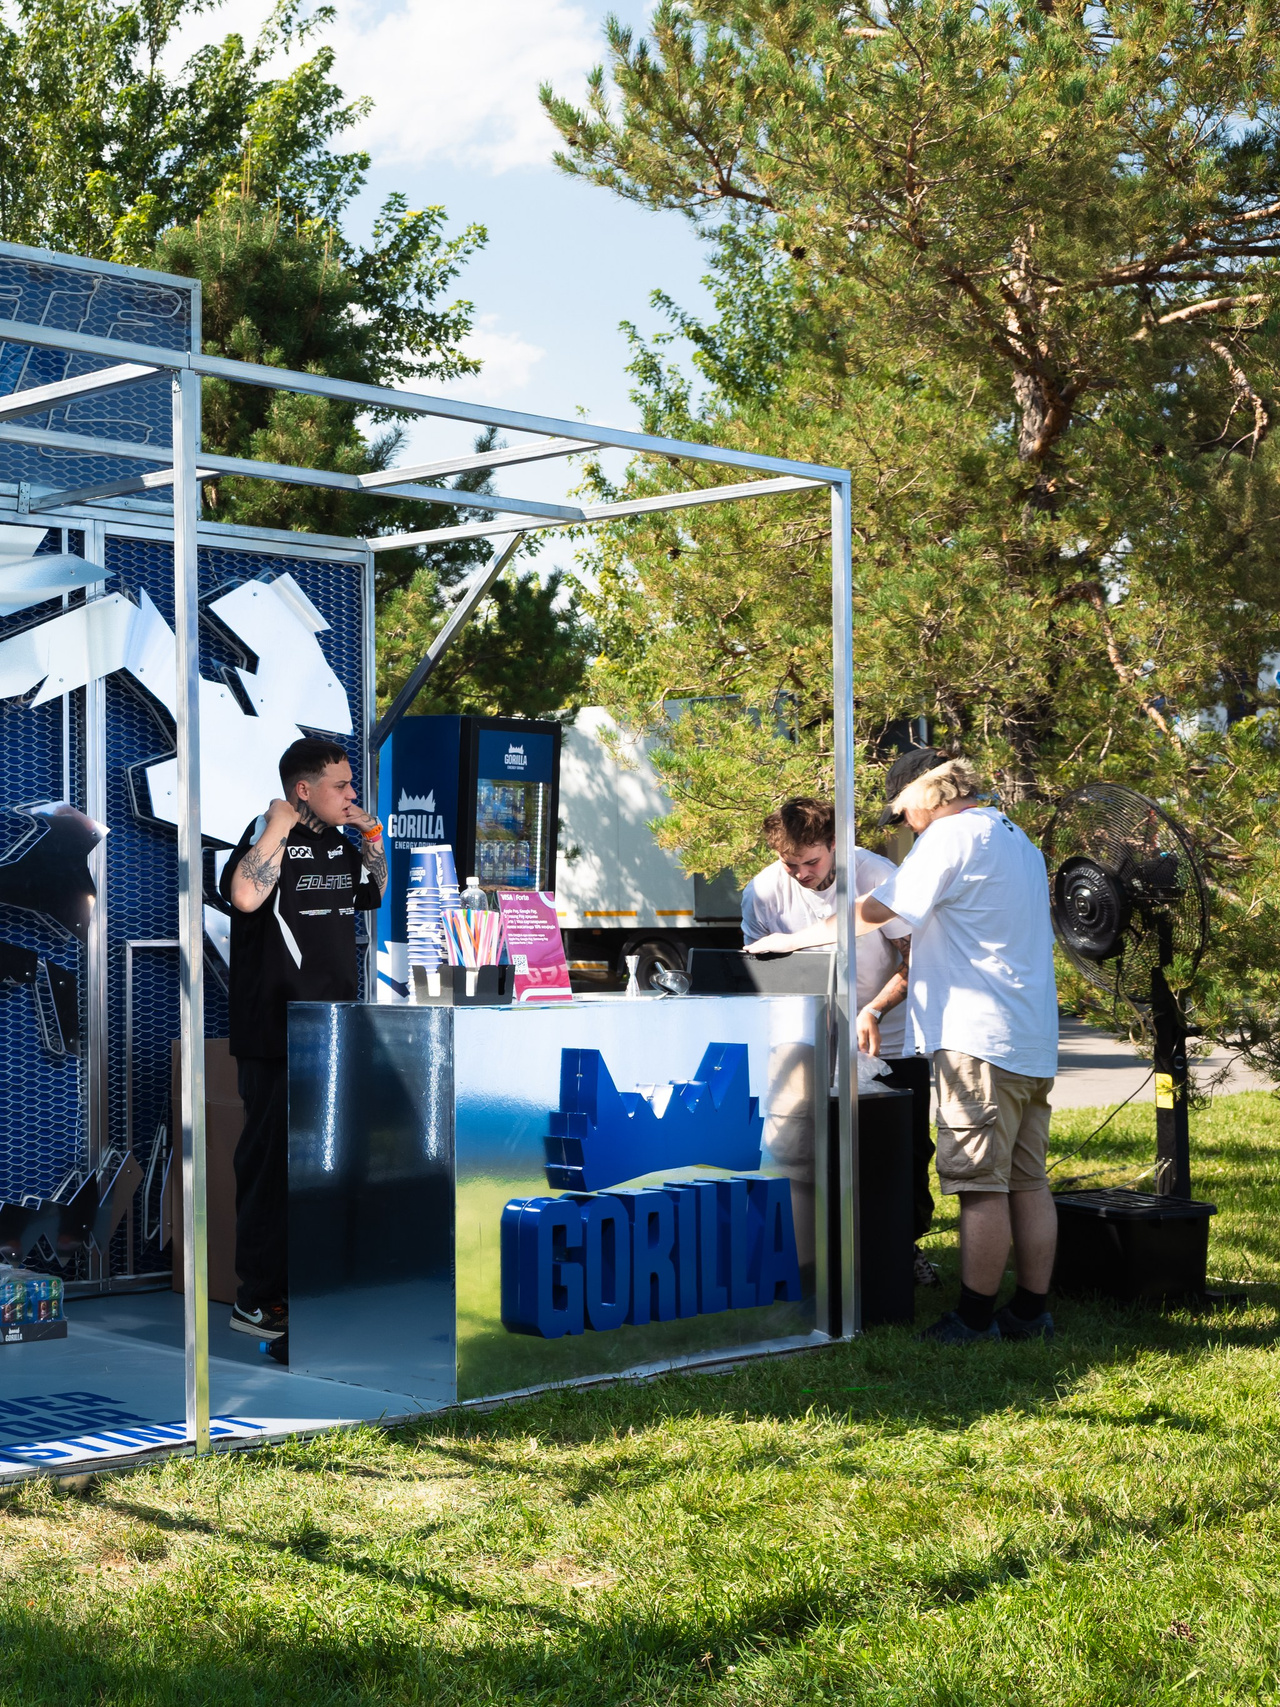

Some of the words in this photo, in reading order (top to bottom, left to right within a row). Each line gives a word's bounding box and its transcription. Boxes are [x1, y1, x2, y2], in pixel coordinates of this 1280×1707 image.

[504, 753, 528, 767] GORILLA
[388, 813, 445, 839] GORILLA
[395, 841, 417, 850] ENERGY
[296, 873, 353, 891] SOLSTICE
[500, 893, 513, 901] VISA
[500, 1174, 802, 1340] GORILLA
[5, 1333, 23, 1342] GORILLA
